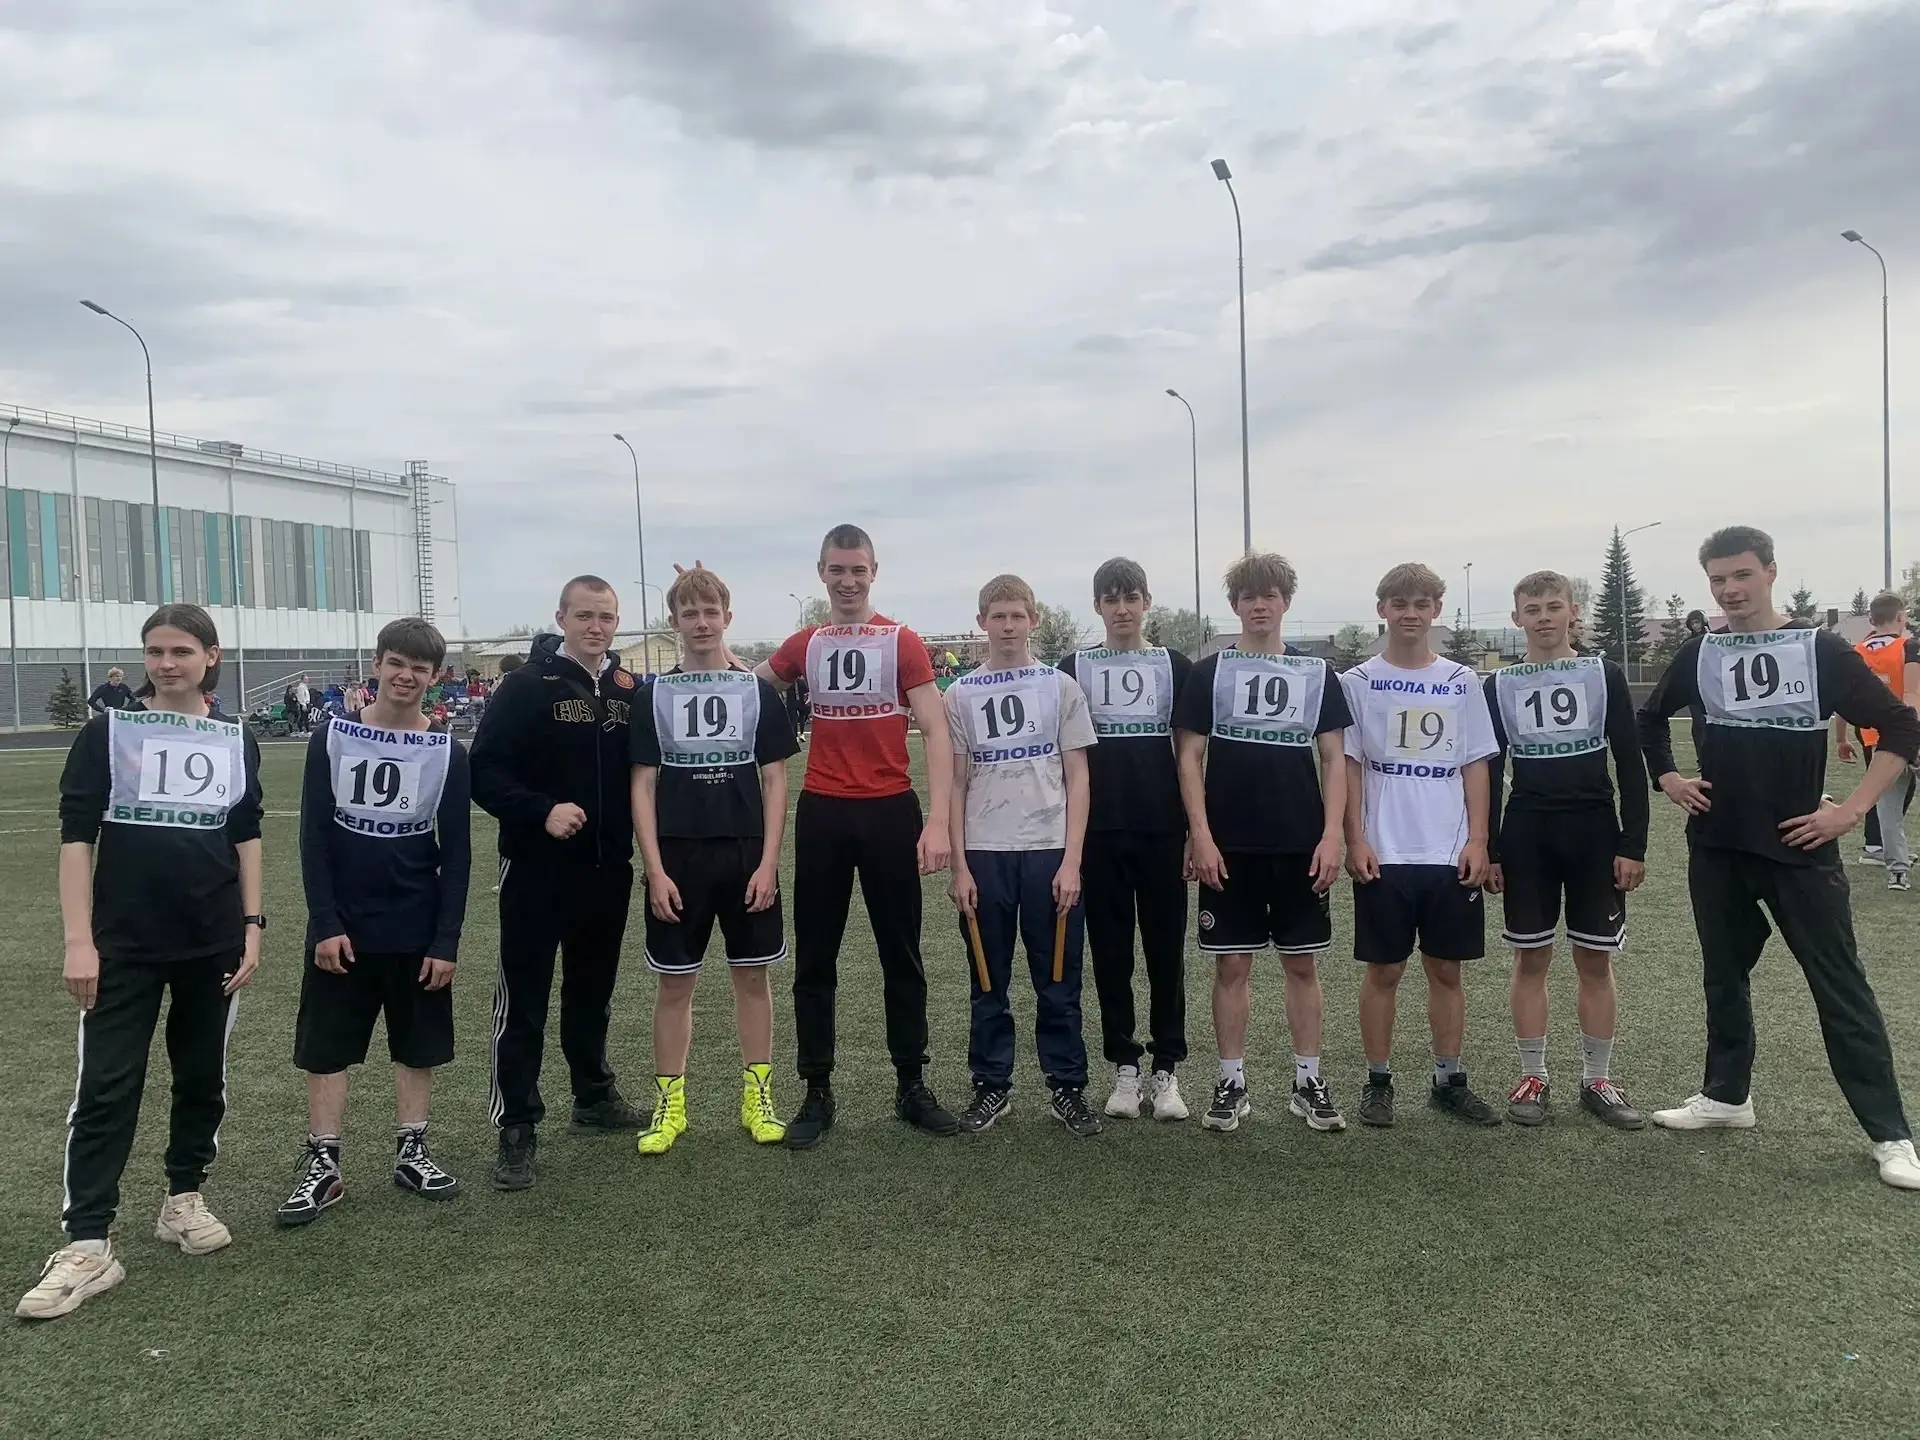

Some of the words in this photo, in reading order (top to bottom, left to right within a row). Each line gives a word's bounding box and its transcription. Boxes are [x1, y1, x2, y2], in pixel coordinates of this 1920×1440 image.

[1763, 633, 1785, 644] №
[827, 649, 866, 691] 19
[1560, 660, 1577, 671] №
[718, 672, 734, 682] №
[960, 671, 1015, 686] ШКОЛА
[1019, 668, 1036, 679] №
[1370, 679, 1426, 695] ШКОЛА
[1431, 683, 1450, 695] №
[1729, 652, 1780, 702] 19
[1783, 680, 1805, 695] 10
[1100, 669, 1144, 707] 19
[1146, 694, 1155, 707] 6
[1244, 674, 1289, 717] 19
[1289, 706, 1297, 719] 7
[683, 695, 728, 738] 19
[728, 725, 737, 737] 2
[813, 702, 894, 717] БЕЛОВО
[980, 694, 1025, 740] 19
[1027, 720, 1036, 733] 3
[1524, 687, 1578, 729] 19
[114, 710, 189, 729] ШКОЛА
[195, 720, 217, 732] №
[222, 725, 240, 737] 19
[333, 720, 397, 744] ШКОЛА
[403, 733, 424, 745] №
[428, 735, 447, 747] 38
[1096, 722, 1167, 735] ЕЛОВО
[1216, 723, 1307, 744] БЕЛОВО
[1394, 710, 1444, 751] 19
[1445, 738, 1453, 752] 5
[972, 742, 1054, 763] БЕЛОВО
[1513, 736, 1601, 756] БЕЛОВО
[663, 750, 750, 765] БЕЛОВО
[151, 749, 214, 797] 19
[216, 784, 226, 799] 9
[1370, 760, 1457, 778] БЕЛОВО
[350, 759, 401, 807] 19
[399, 796, 409, 809] 8
[113, 805, 225, 826] БЕЛОВО
